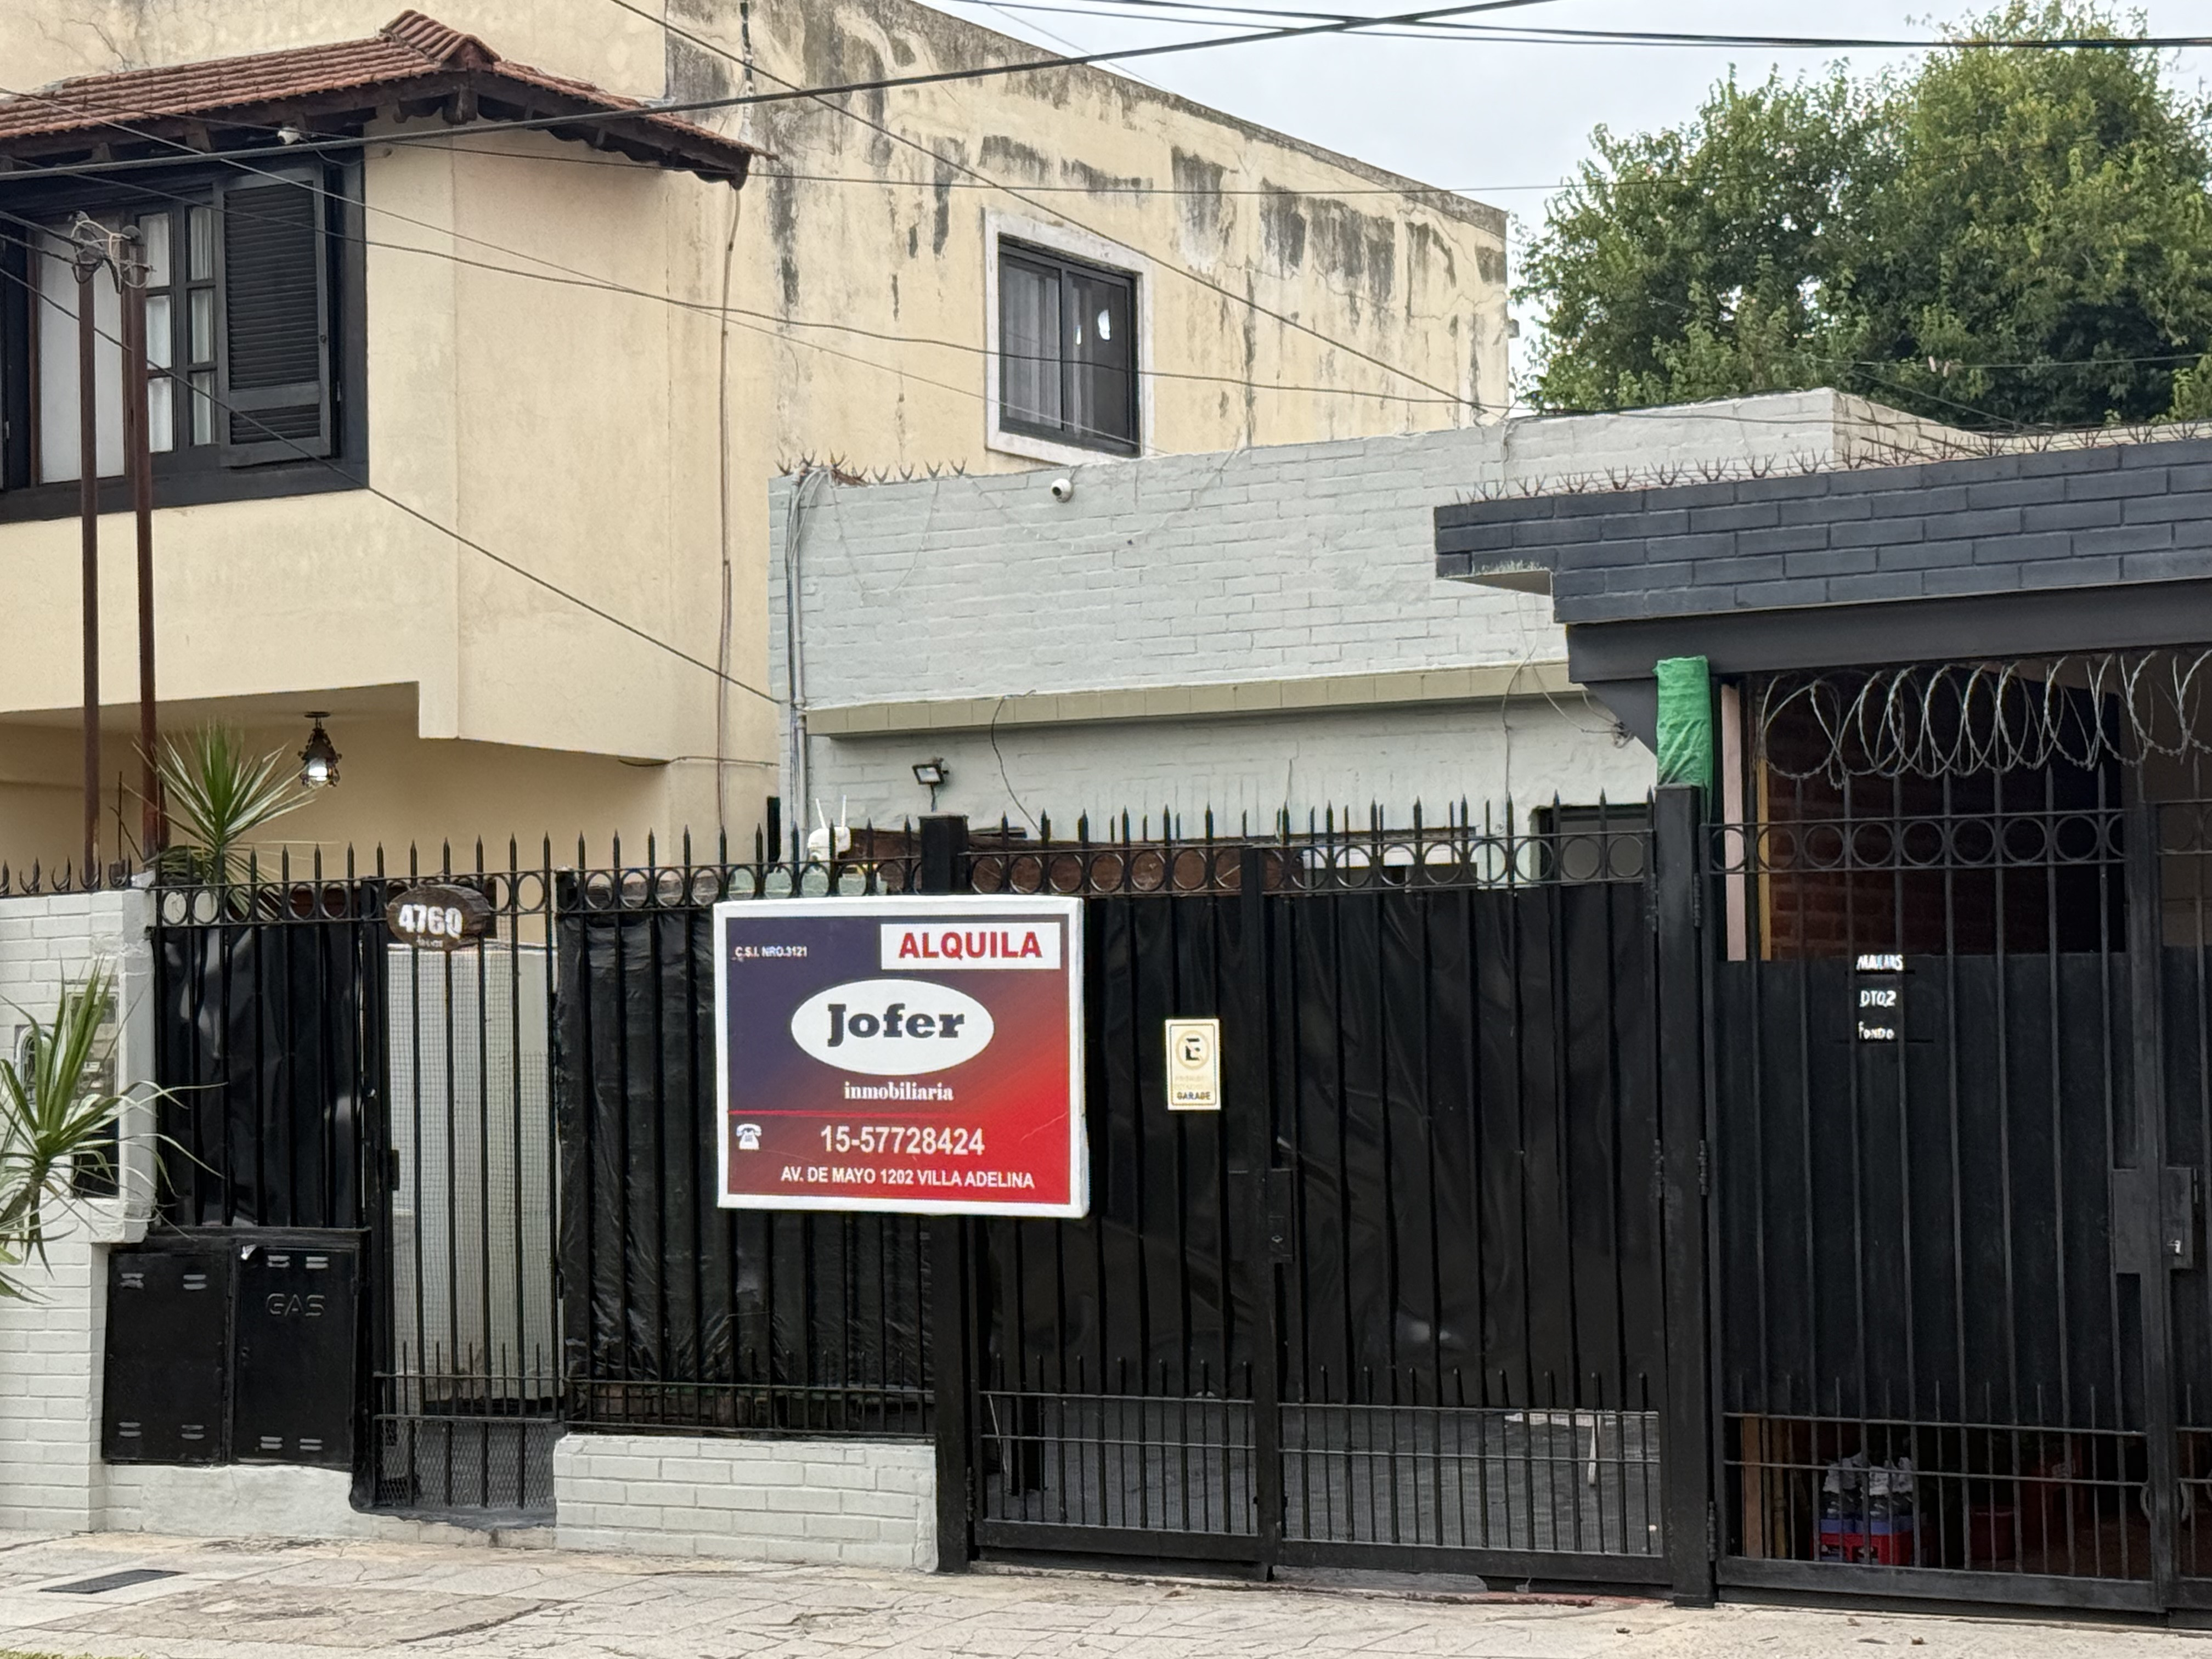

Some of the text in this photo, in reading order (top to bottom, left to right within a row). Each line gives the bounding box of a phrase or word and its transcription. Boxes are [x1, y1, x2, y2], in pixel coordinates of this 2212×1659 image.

[398, 904, 463, 940] 4760
[899, 931, 1043, 961] ALQUILA
[827, 1003, 966, 1048] Jofer
[844, 1081, 955, 1102] inmobiliaria
[1176, 1091, 1211, 1101] GARAGE
[821, 1125, 985, 1156] 15-57728424
[781, 1166, 1035, 1188] AV. DE MAYO 1202 VILLA ADELINA
[266, 1293, 326, 1317] GAS
